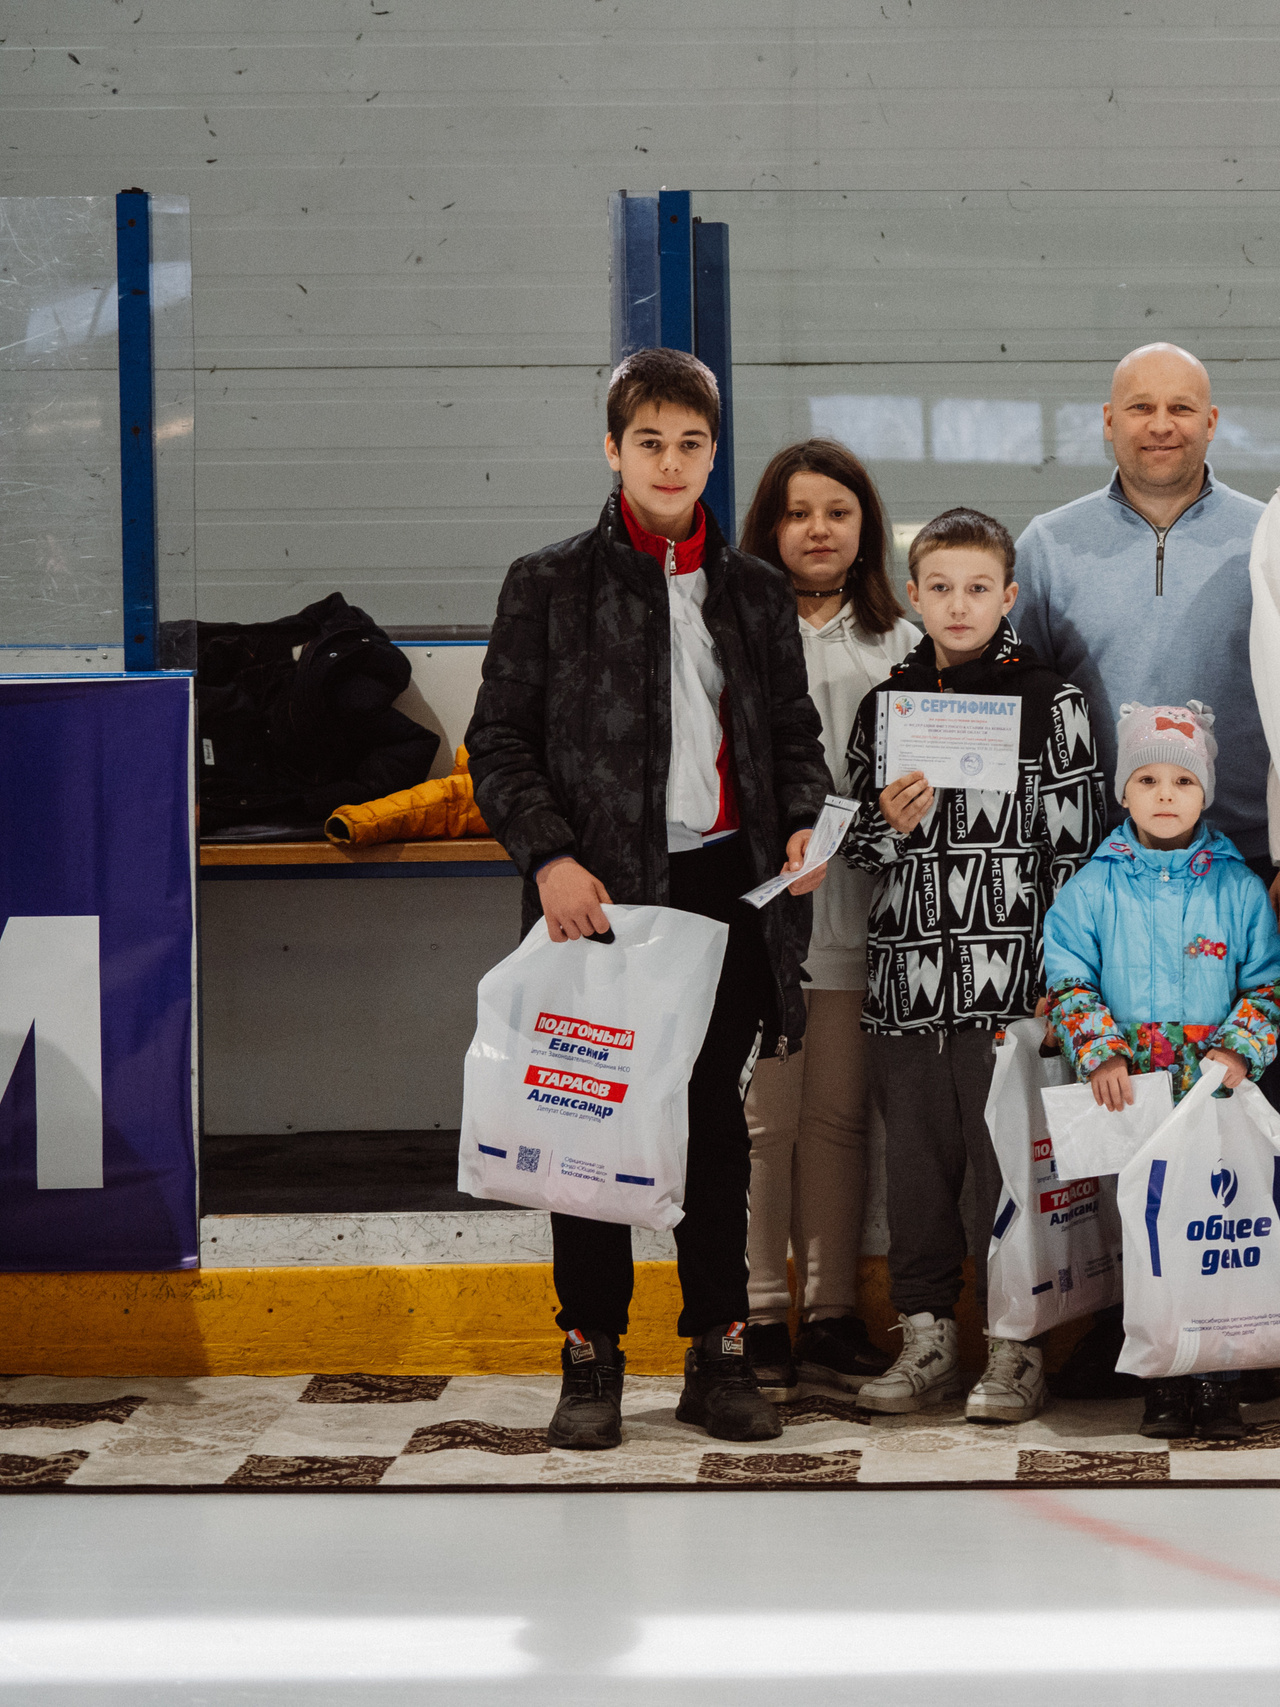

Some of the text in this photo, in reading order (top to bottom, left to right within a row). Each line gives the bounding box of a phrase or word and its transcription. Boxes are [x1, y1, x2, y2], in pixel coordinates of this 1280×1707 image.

[920, 699, 1017, 716] СЕРТИФИКАТ
[1051, 706, 1069, 769] MENCLOR
[955, 786, 967, 840] ENCLOR
[1024, 775, 1033, 839] MENCLOR
[922, 863, 935, 928] MENCLOR
[991, 858, 1005, 923] MENCLOR
[896, 952, 910, 1018] MENCLOR
[959, 945, 973, 1009] MENCLOR
[527, 1089, 613, 1119] Александр
[538, 1070, 611, 1097] ТАРАСОВ
